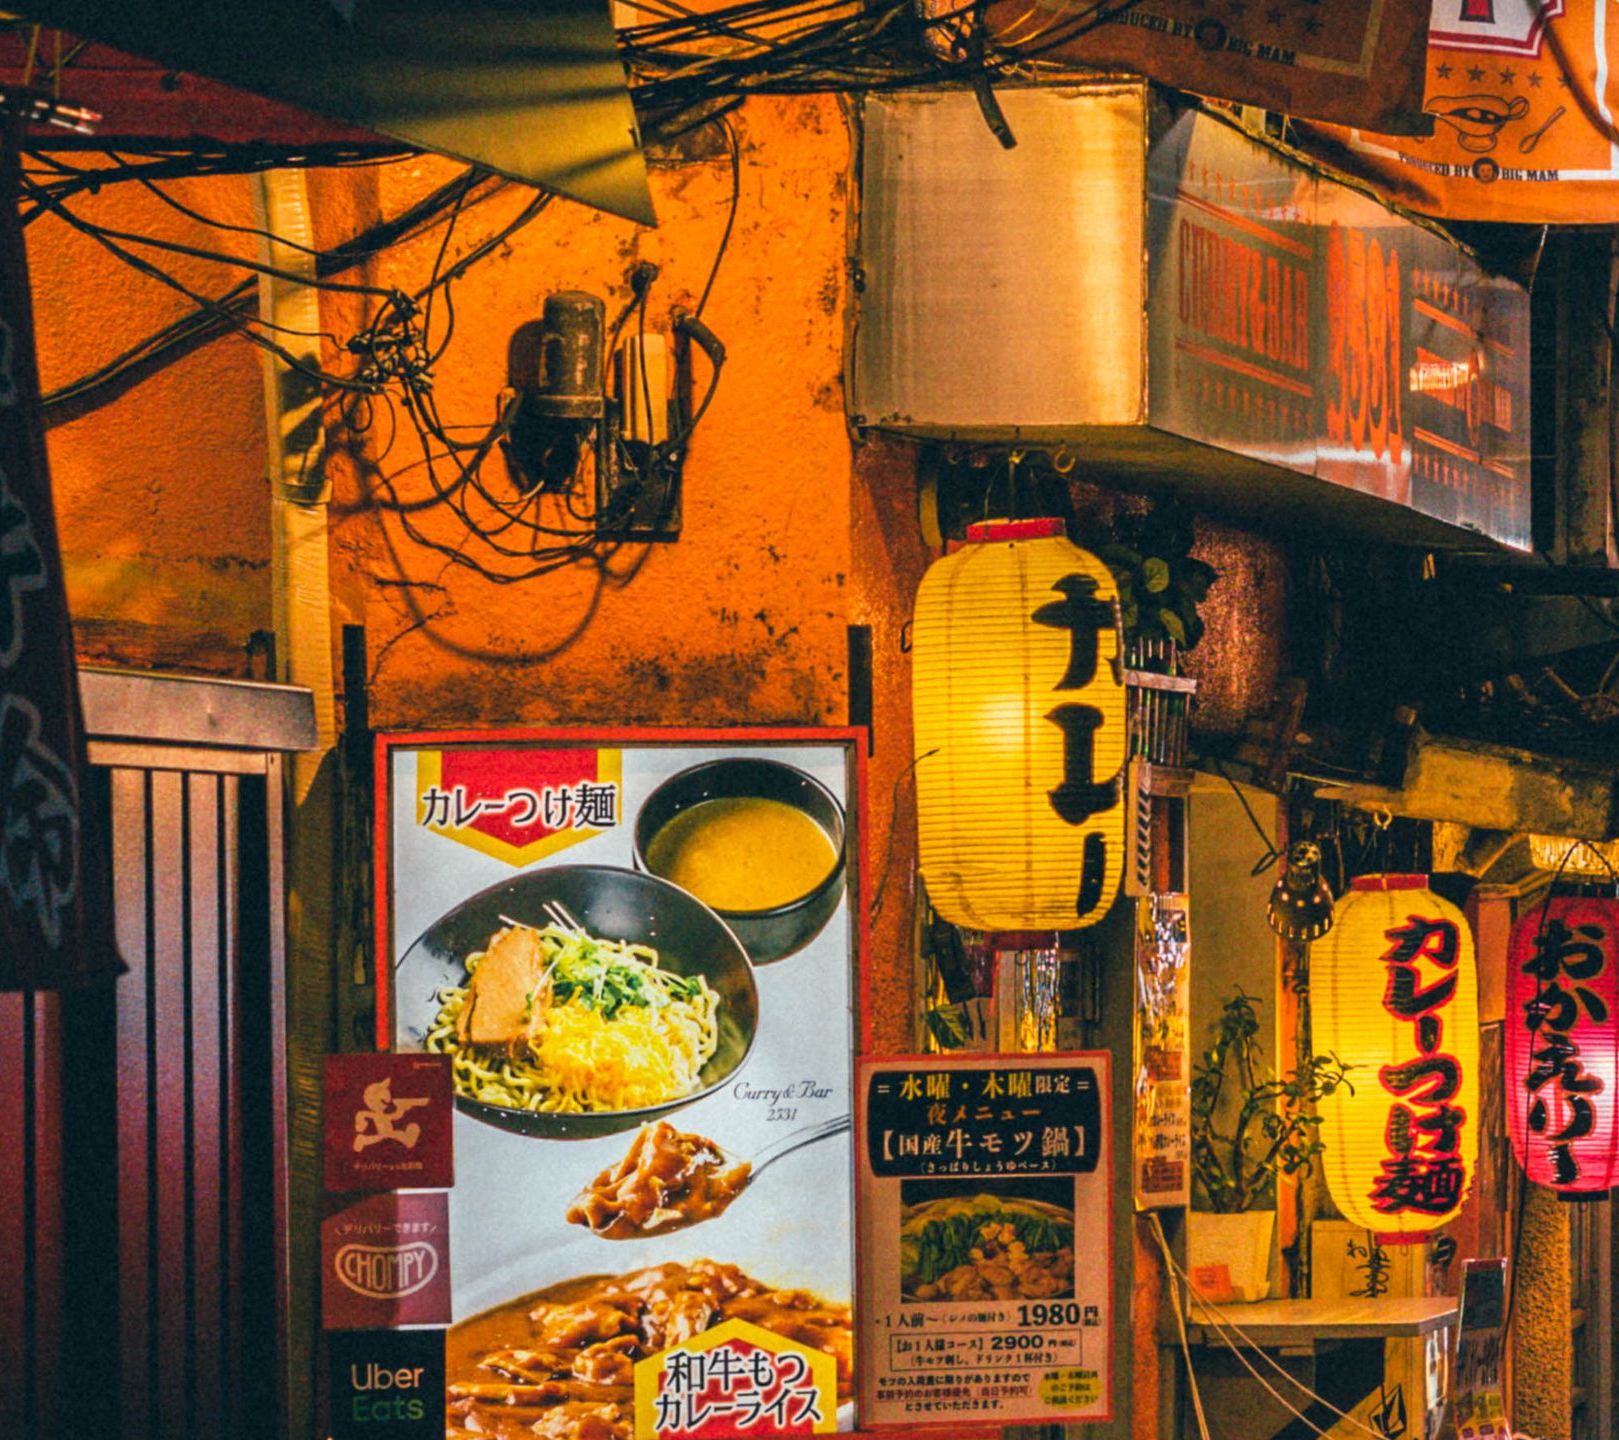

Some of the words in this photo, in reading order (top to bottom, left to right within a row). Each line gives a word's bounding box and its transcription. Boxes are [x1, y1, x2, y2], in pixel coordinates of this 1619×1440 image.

[1502, 167, 1523, 180] BIG
[1527, 169, 1559, 181] MAM
[422, 783, 615, 828] カレーつけ麺
[1371, 914, 1467, 1216] カレーつけ麺
[927, 1102, 1041, 1126] 夜メニュー
[345, 1250, 426, 1292] CHOMPY
[351, 1364, 424, 1391] Uber
[666, 1350, 808, 1394] 和牛もつ
[352, 1395, 424, 1422] Eats
[654, 1390, 822, 1431] カレーライス
